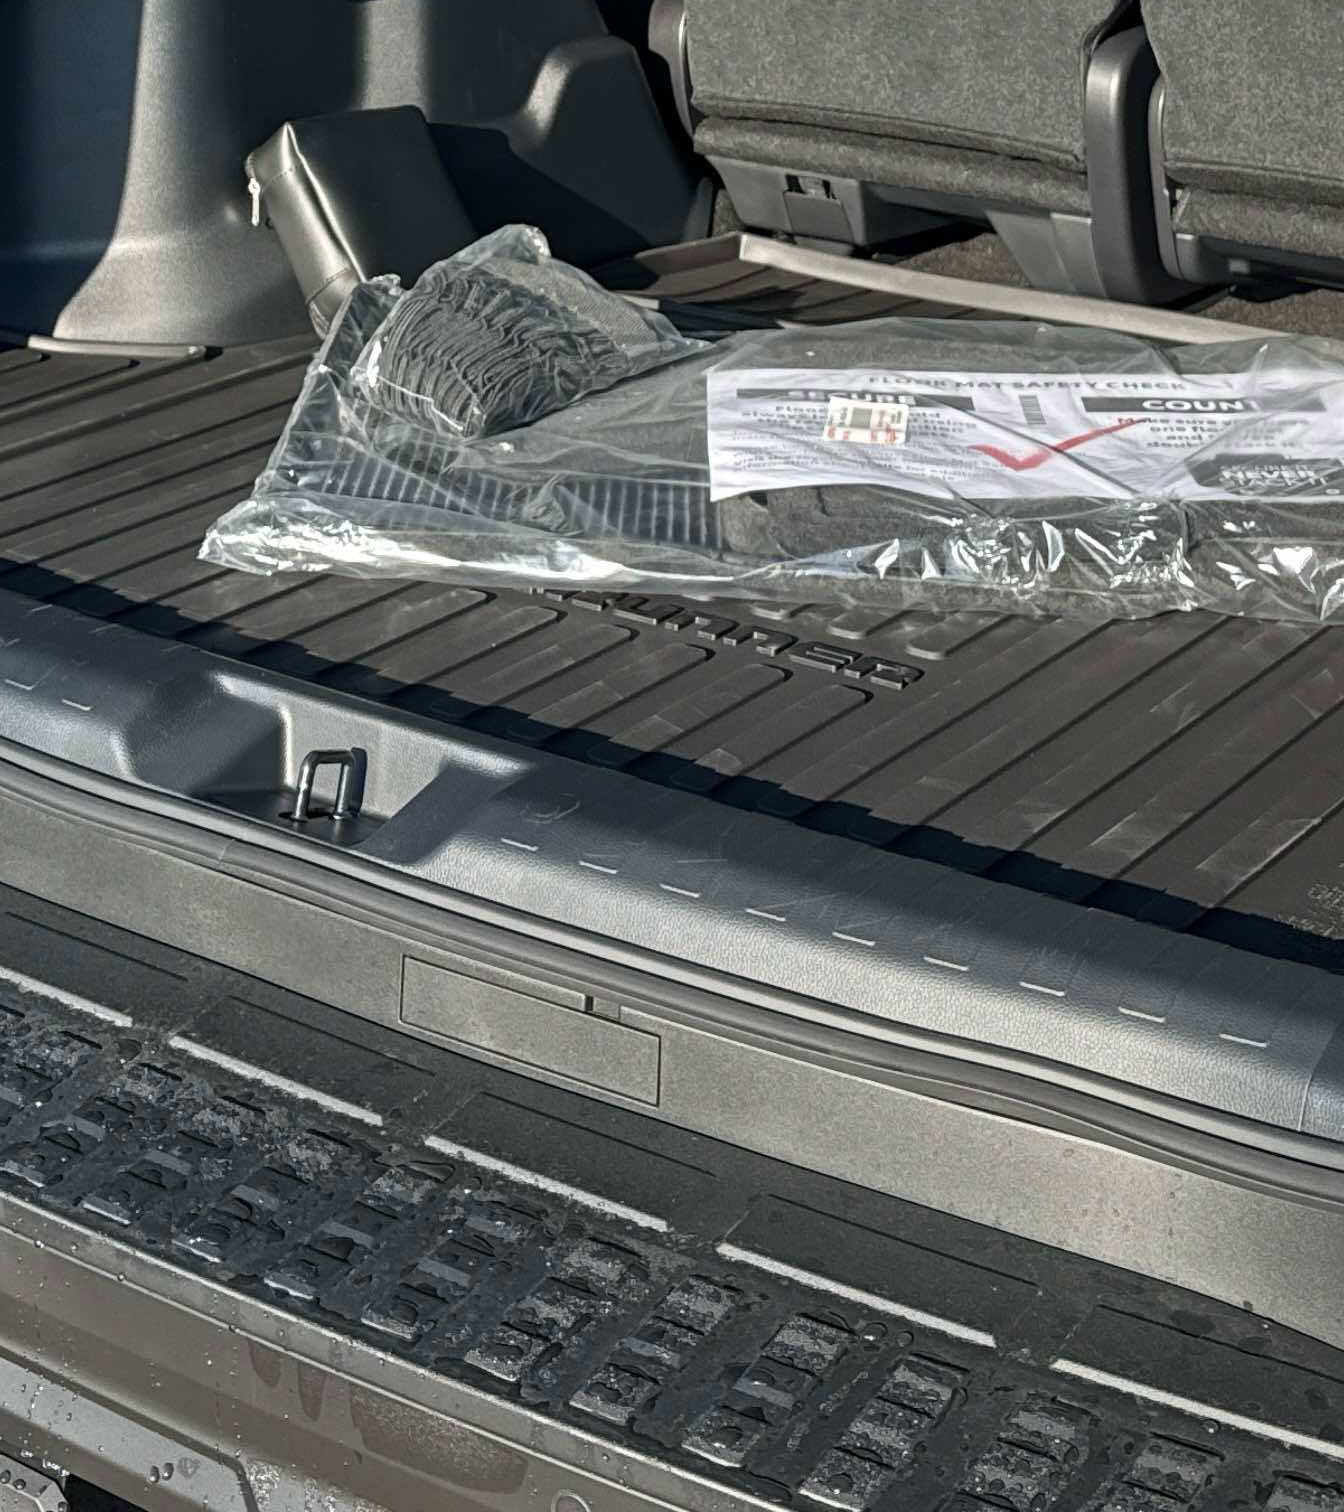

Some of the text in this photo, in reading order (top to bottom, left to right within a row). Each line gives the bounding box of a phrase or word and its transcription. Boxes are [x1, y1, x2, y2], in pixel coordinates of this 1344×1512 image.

[1012, 381, 1097, 390] SAFETY
[1106, 381, 1186, 390] CHECK
[528, 586, 924, 690] RUNNER
